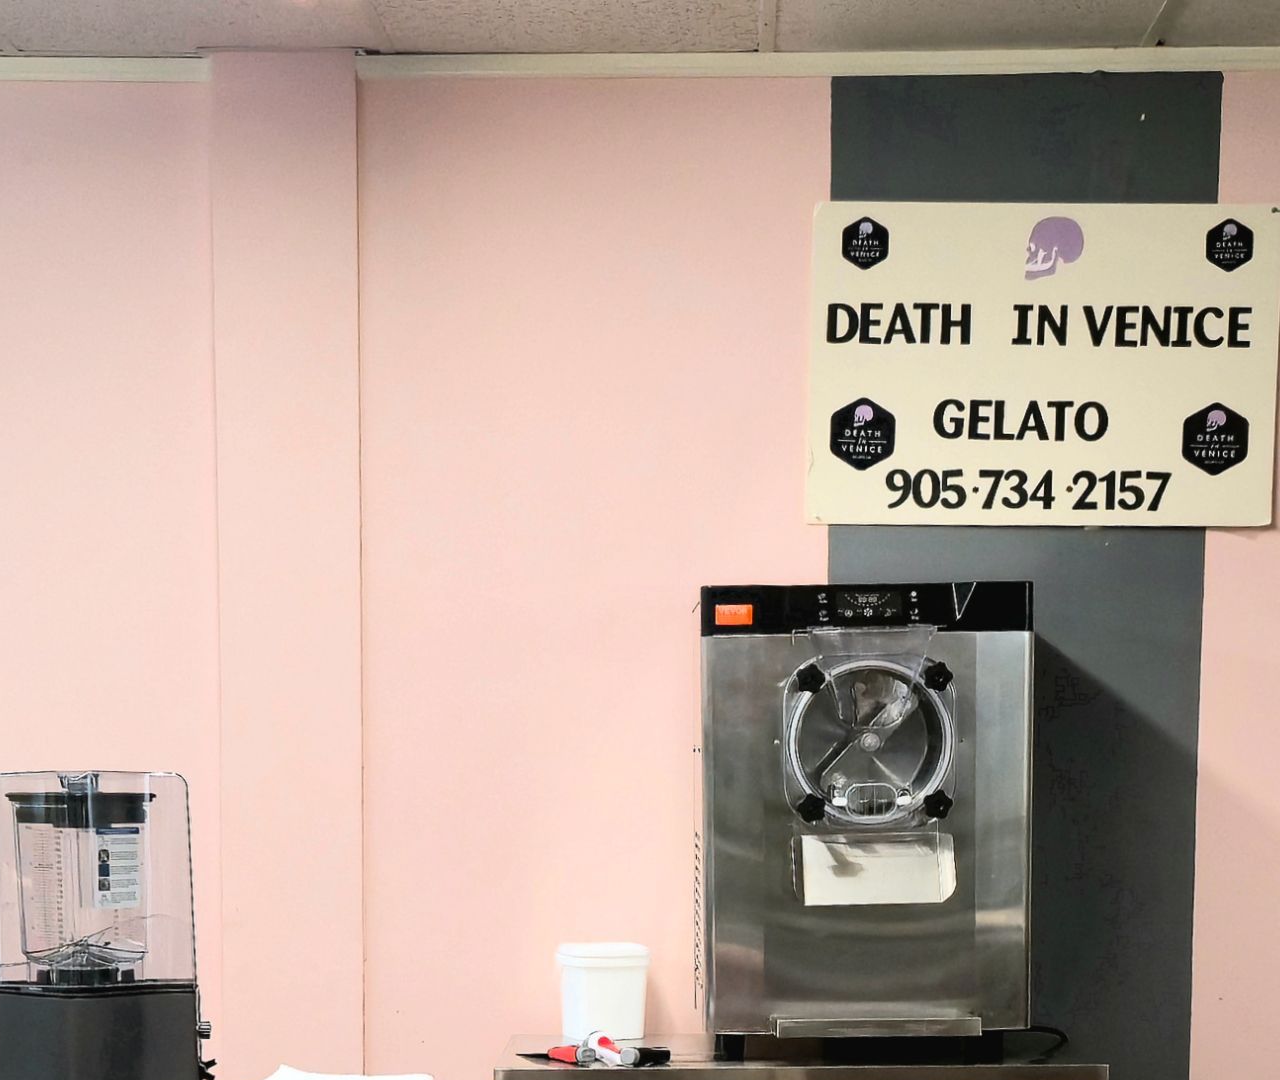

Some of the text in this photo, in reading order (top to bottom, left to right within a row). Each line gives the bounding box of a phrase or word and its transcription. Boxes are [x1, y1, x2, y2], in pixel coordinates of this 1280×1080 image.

[826, 302, 1253, 349] DEATH IN VENICE
[932, 398, 1109, 442] GELATO
[844, 428, 881, 438] DEATH
[1196, 434, 1235, 442] DEATH
[841, 444, 883, 454] VENICE
[1193, 449, 1236, 458] VENICE
